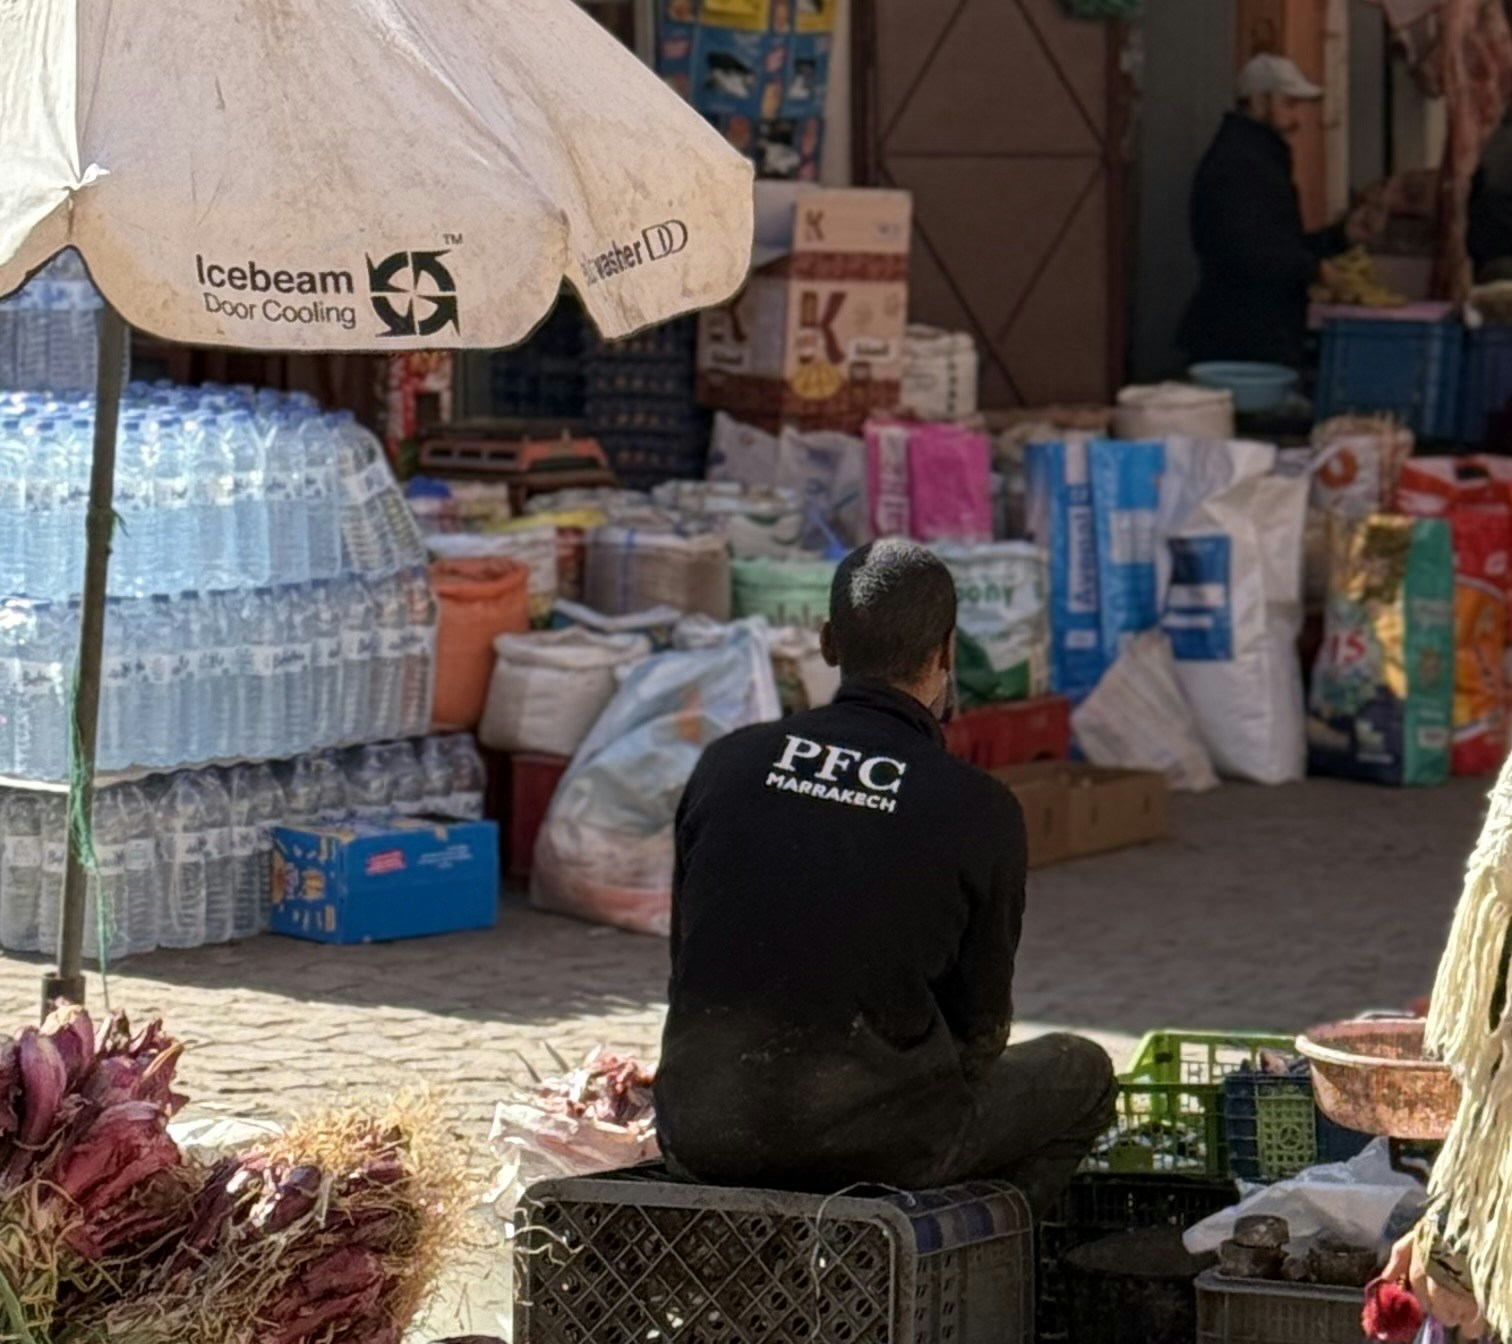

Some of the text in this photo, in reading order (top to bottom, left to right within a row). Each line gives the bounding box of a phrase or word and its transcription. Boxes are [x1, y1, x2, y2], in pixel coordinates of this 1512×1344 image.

[442, 233, 464, 246] TM
[196, 253, 355, 295] Icebeam
[203, 291, 356, 330] Door Cooling
[772, 734, 907, 794] PFC
[765, 772, 897, 813] MARRAKECH
